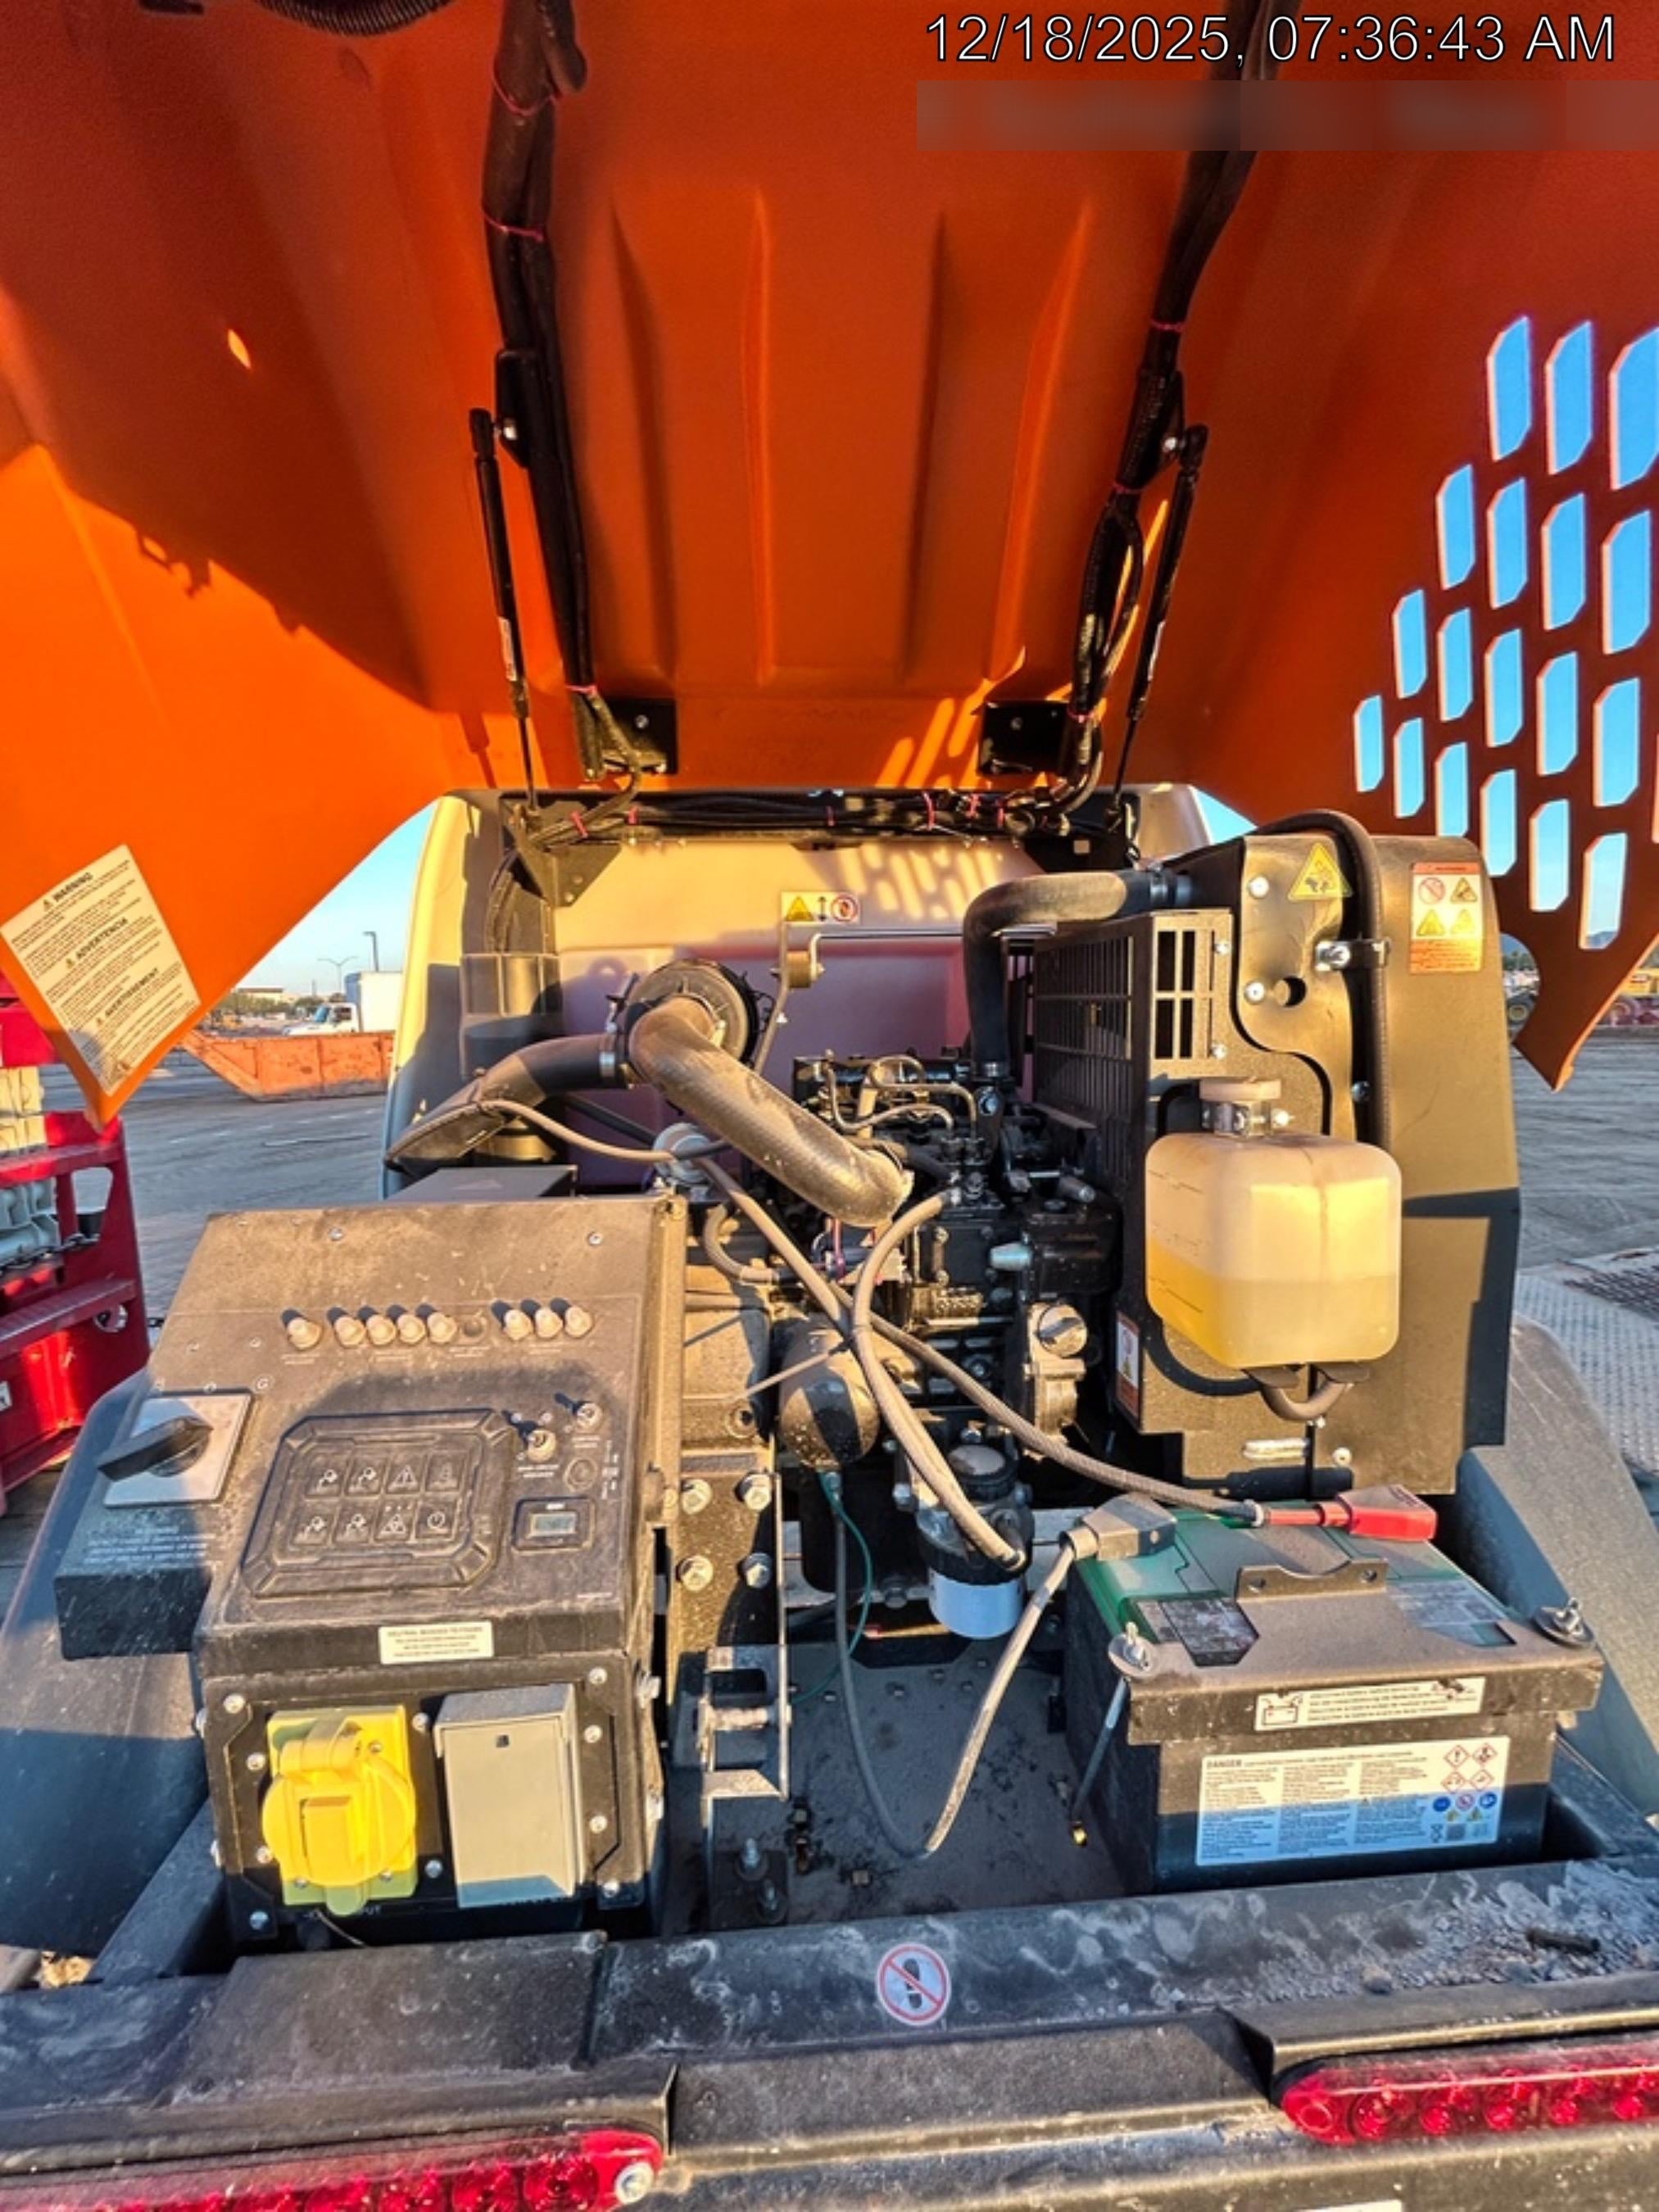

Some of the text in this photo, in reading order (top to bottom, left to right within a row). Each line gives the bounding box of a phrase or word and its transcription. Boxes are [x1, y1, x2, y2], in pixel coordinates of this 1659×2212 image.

[52, 872, 93, 902] WARNING
[76, 917, 128, 959] ADVERTENCIA
[1206, 1759, 1242, 1769] DANGER
